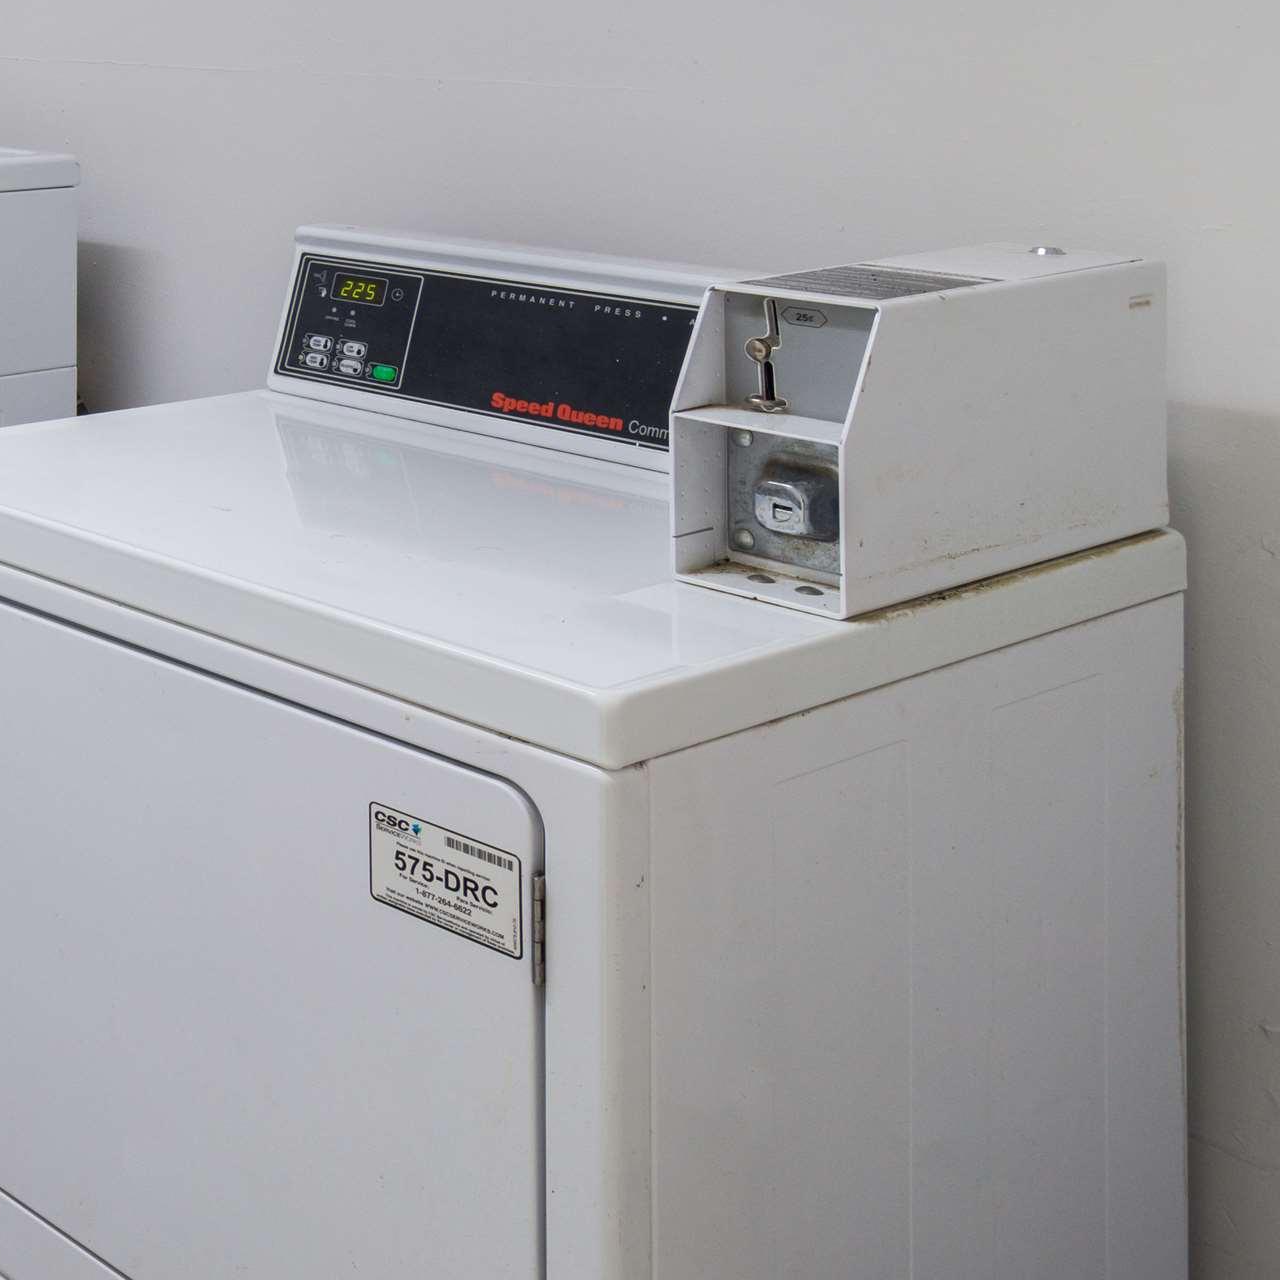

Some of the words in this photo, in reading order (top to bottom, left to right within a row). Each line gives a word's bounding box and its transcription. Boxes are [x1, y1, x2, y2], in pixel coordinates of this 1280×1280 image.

[341, 281, 376, 300] 225
[491, 290, 576, 309] PERMANENT
[594, 305, 642, 319] PRESS
[491, 392, 554, 418] Speed
[556, 404, 624, 432] Queen
[374, 810, 410, 832] CSC
[394, 849, 498, 909] 575-DRC
